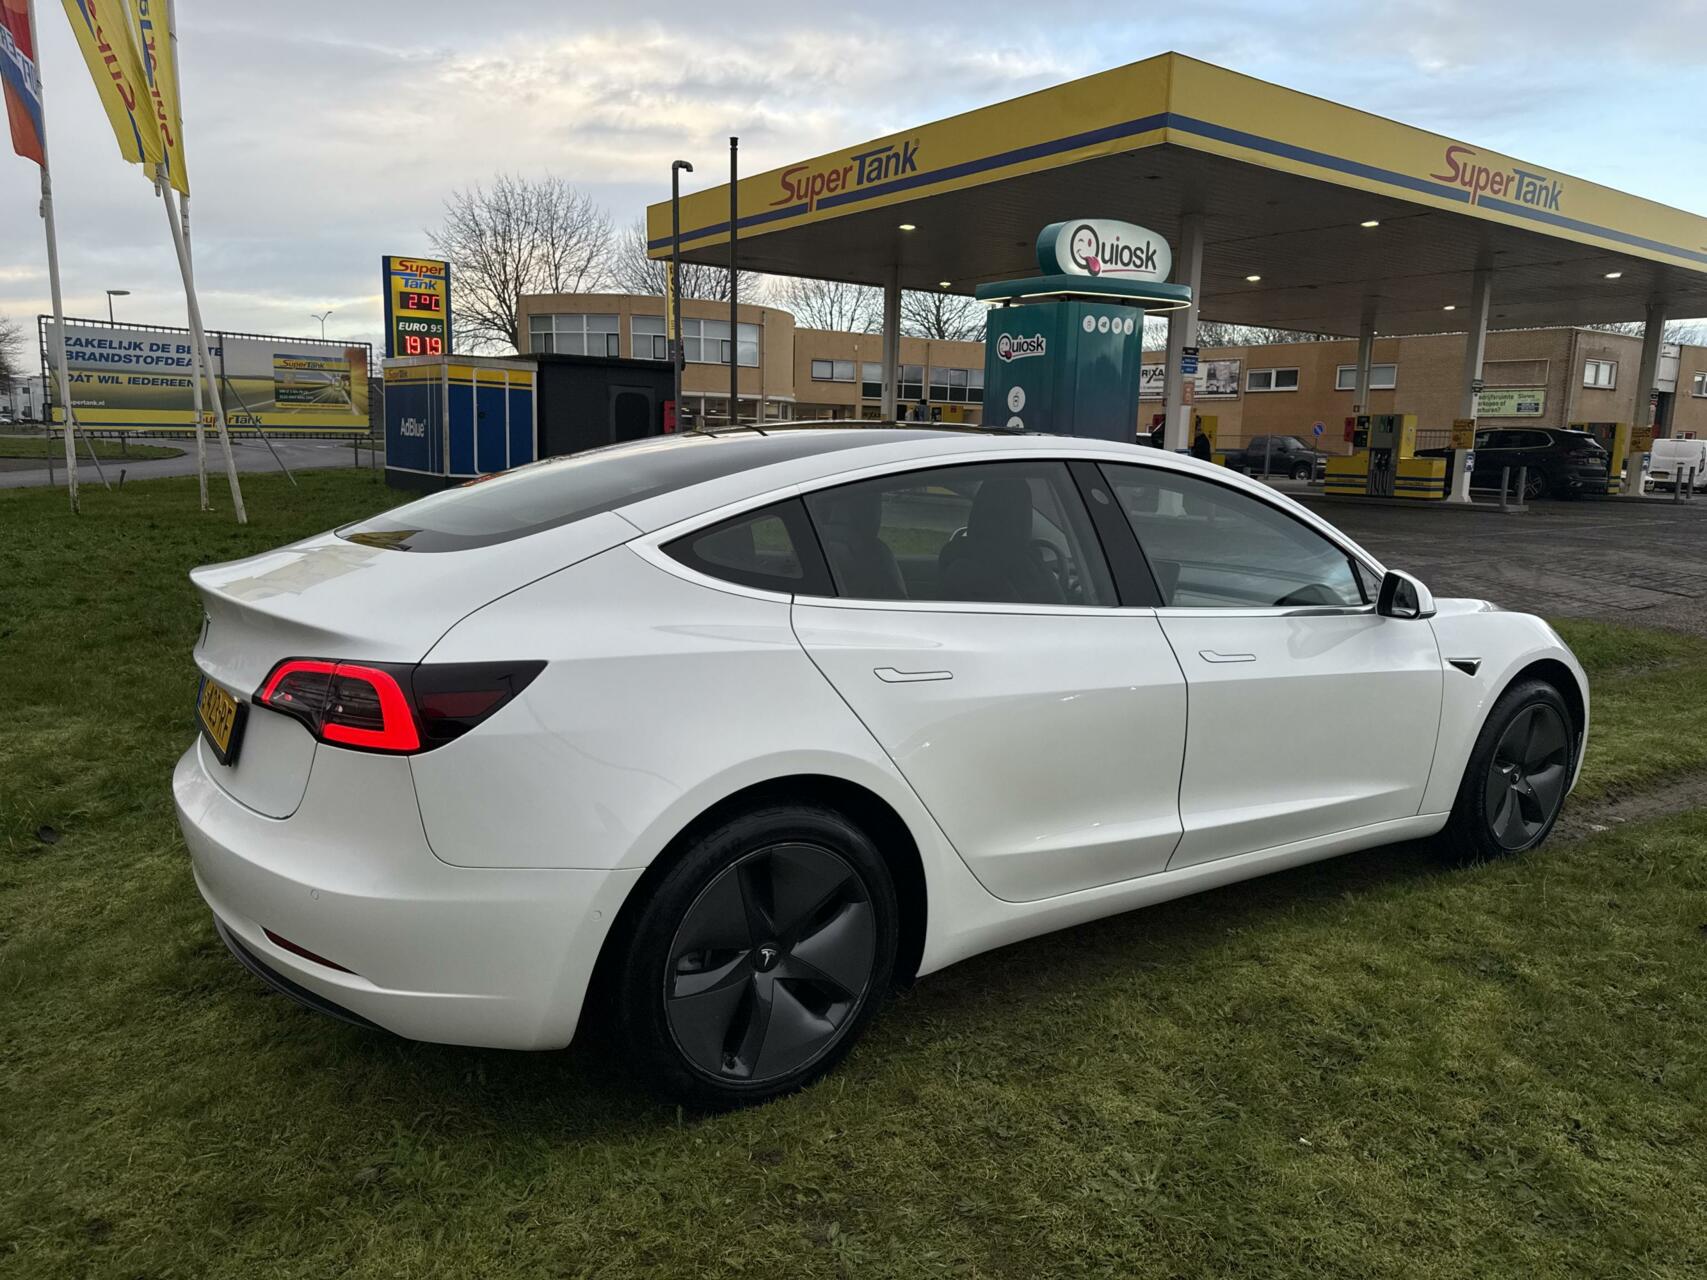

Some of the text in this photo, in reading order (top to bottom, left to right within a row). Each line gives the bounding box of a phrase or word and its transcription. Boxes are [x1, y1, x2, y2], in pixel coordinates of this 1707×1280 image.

[769, 141, 919, 212] SuperTank
[1430, 145, 1563, 211] SuperTank
[1070, 224, 1157, 276] Quiosk
[391, 260, 444, 277] Super
[400, 277, 437, 290] Tank
[398, 321, 442, 333] EURO 95
[64, 336, 144, 352] ZAKELIJK
[149, 342, 171, 354] DE
[998, 335, 1044, 359] Quiosk
[98, 375, 123, 385] WIL
